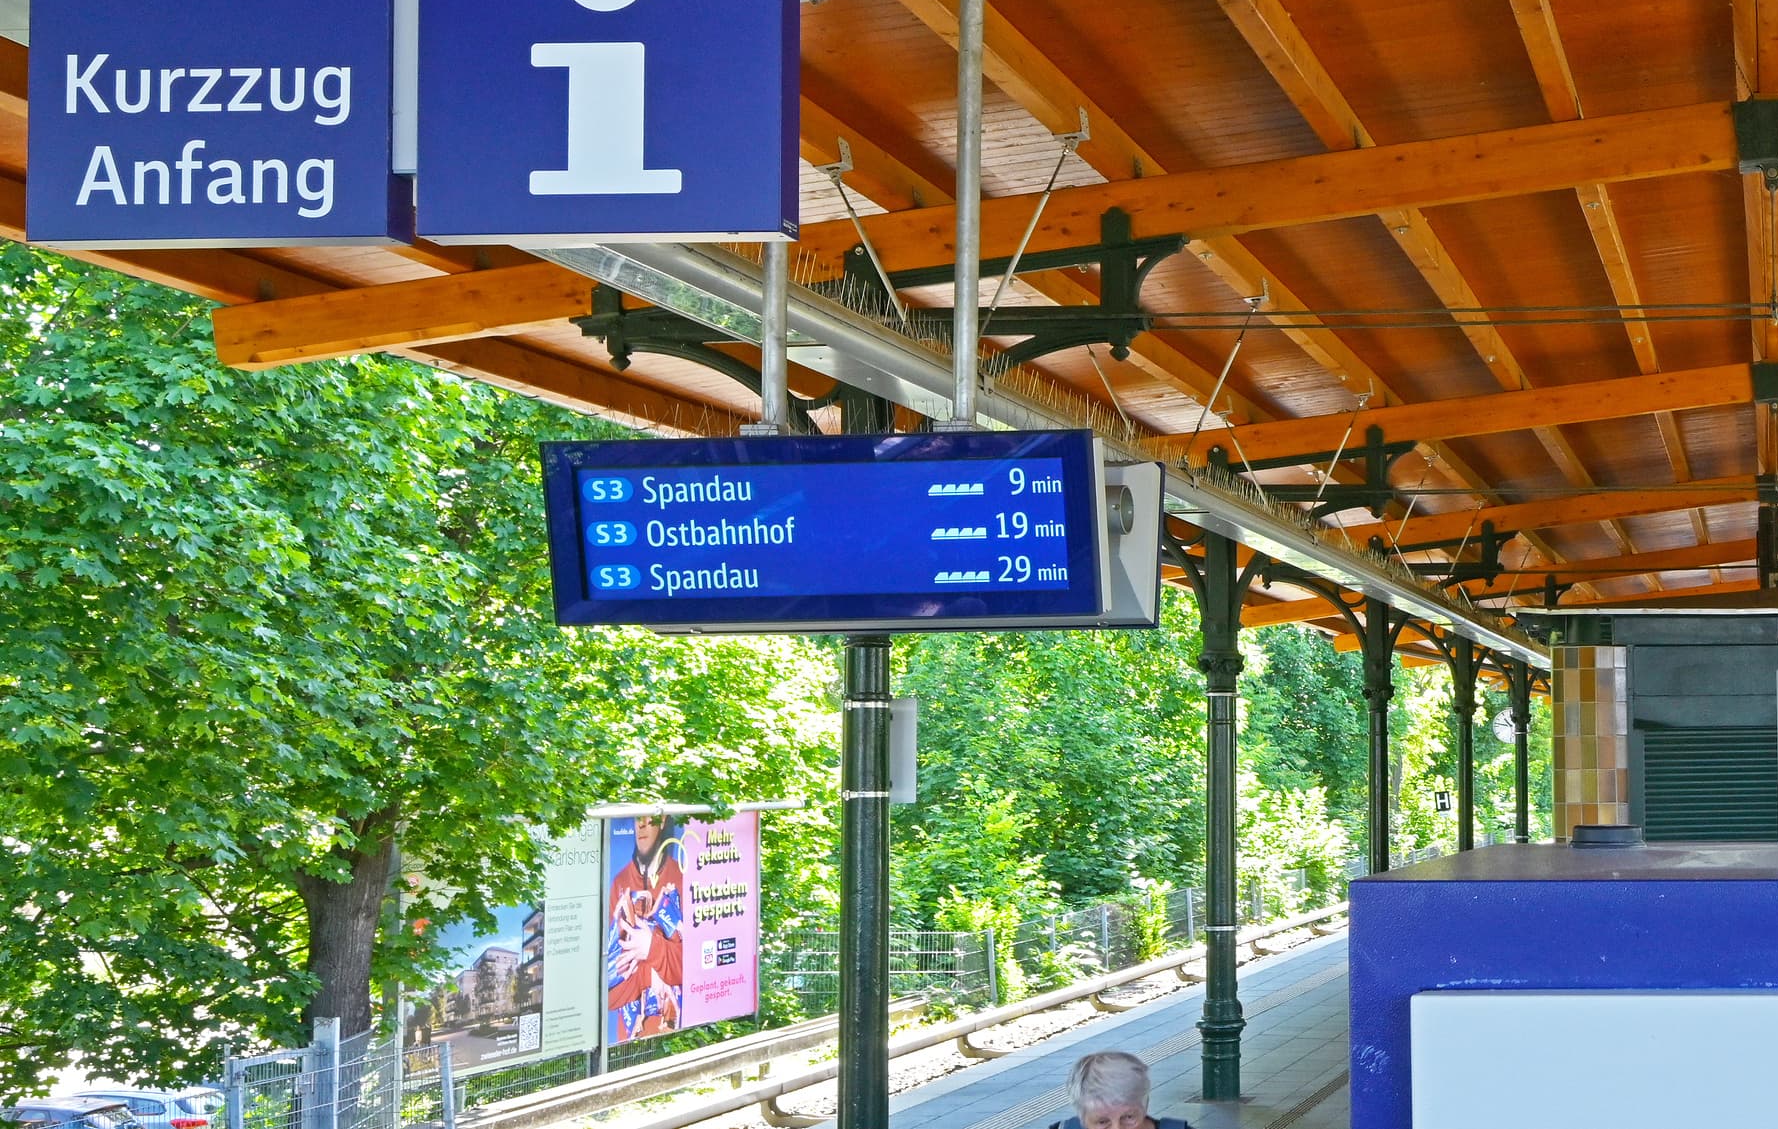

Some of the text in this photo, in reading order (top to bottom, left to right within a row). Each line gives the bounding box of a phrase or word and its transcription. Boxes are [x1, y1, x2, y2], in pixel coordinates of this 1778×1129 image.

[66, 54, 351, 126] Kurzzug
[75, 139, 335, 218] Anfang
[642, 475, 752, 510] Spandau
[1009, 467, 1026, 496] 9
[1032, 476, 1062, 493] min
[646, 516, 795, 547] Ostbahnhof
[995, 511, 1029, 539] 19
[1035, 520, 1065, 537] min
[650, 562, 759, 597] Spandau
[998, 555, 1031, 583] 29
[1038, 564, 1068, 581] min
[1436, 792, 1450, 810] H
[706, 829, 735, 848] Mehr
[697, 845, 741, 870] gekauft.
[690, 879, 749, 905] Trotzdem
[693, 899, 747, 928] gespart.
